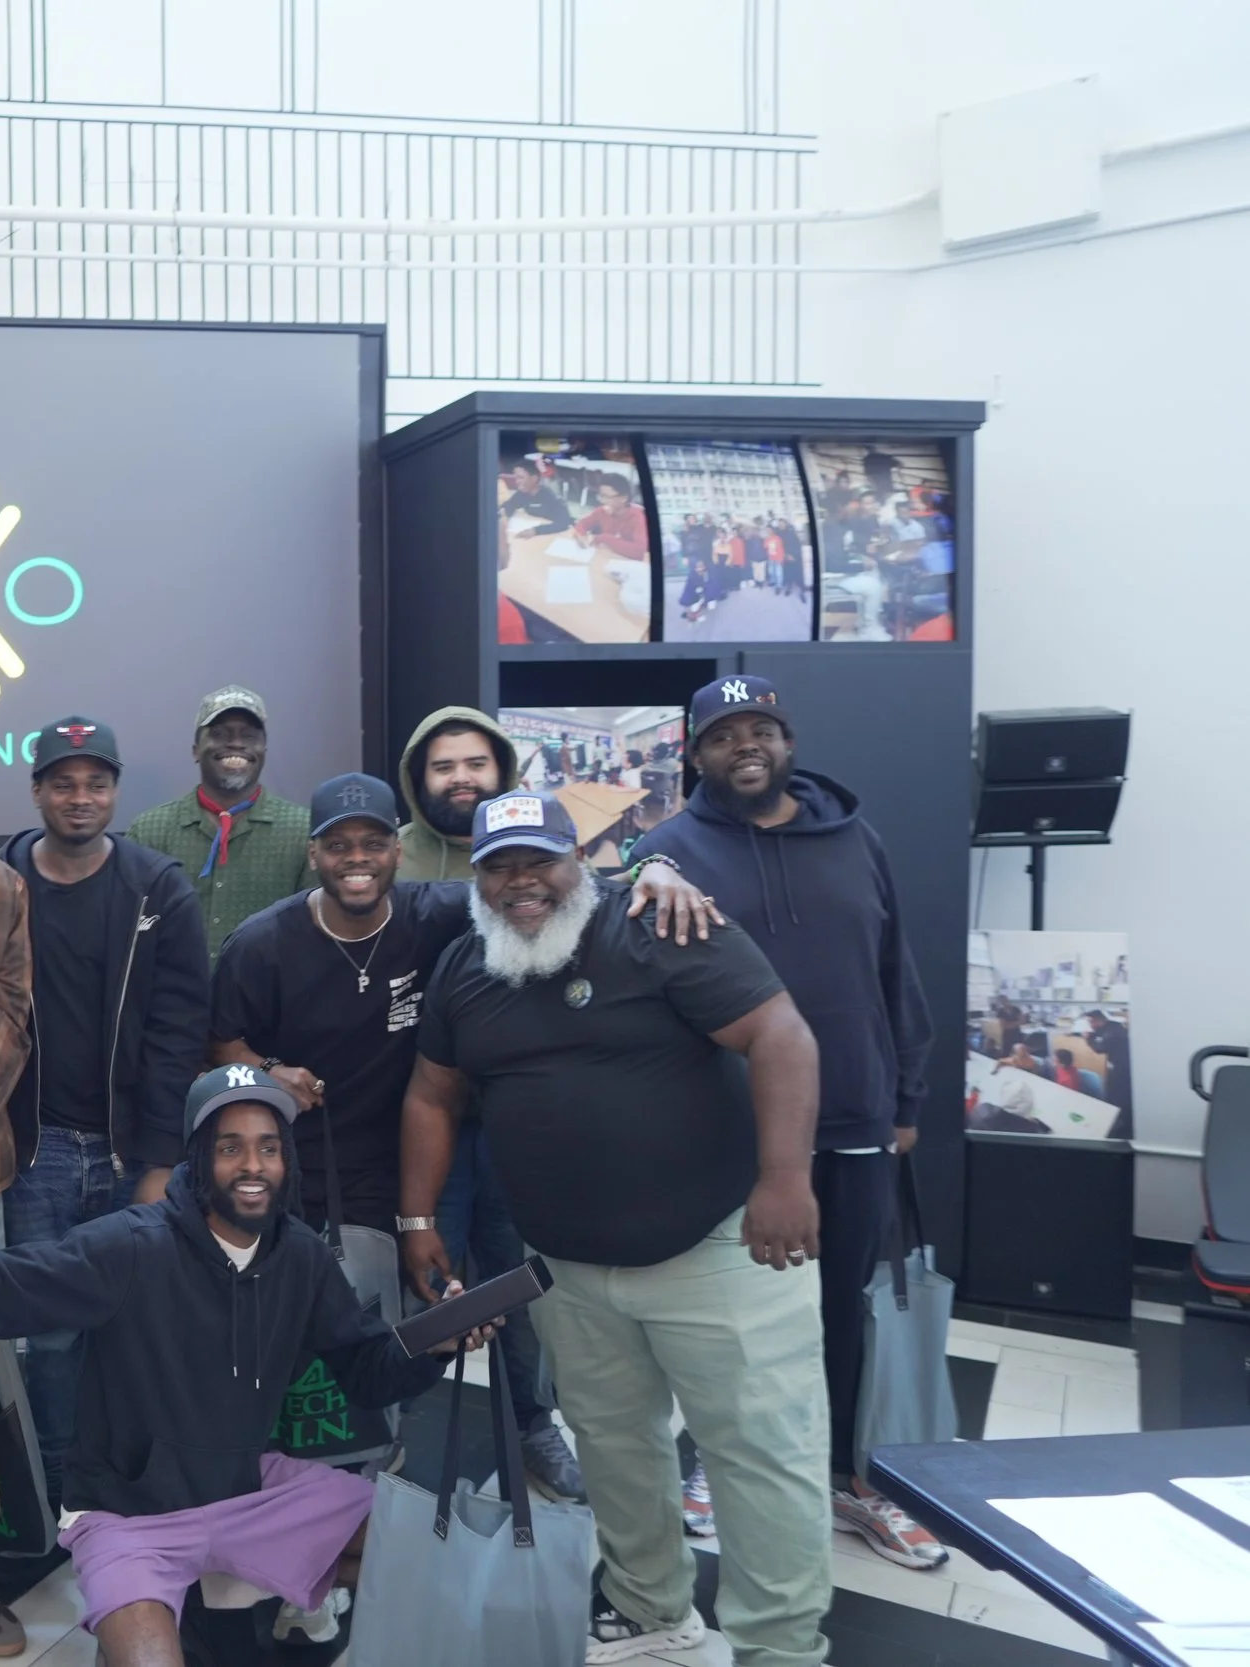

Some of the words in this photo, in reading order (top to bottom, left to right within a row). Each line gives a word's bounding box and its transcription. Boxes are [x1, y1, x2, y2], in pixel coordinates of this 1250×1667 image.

[721, 679, 750, 703] NY
[225, 1065, 257, 1088] NY
[285, 1389, 348, 1418] ECH
